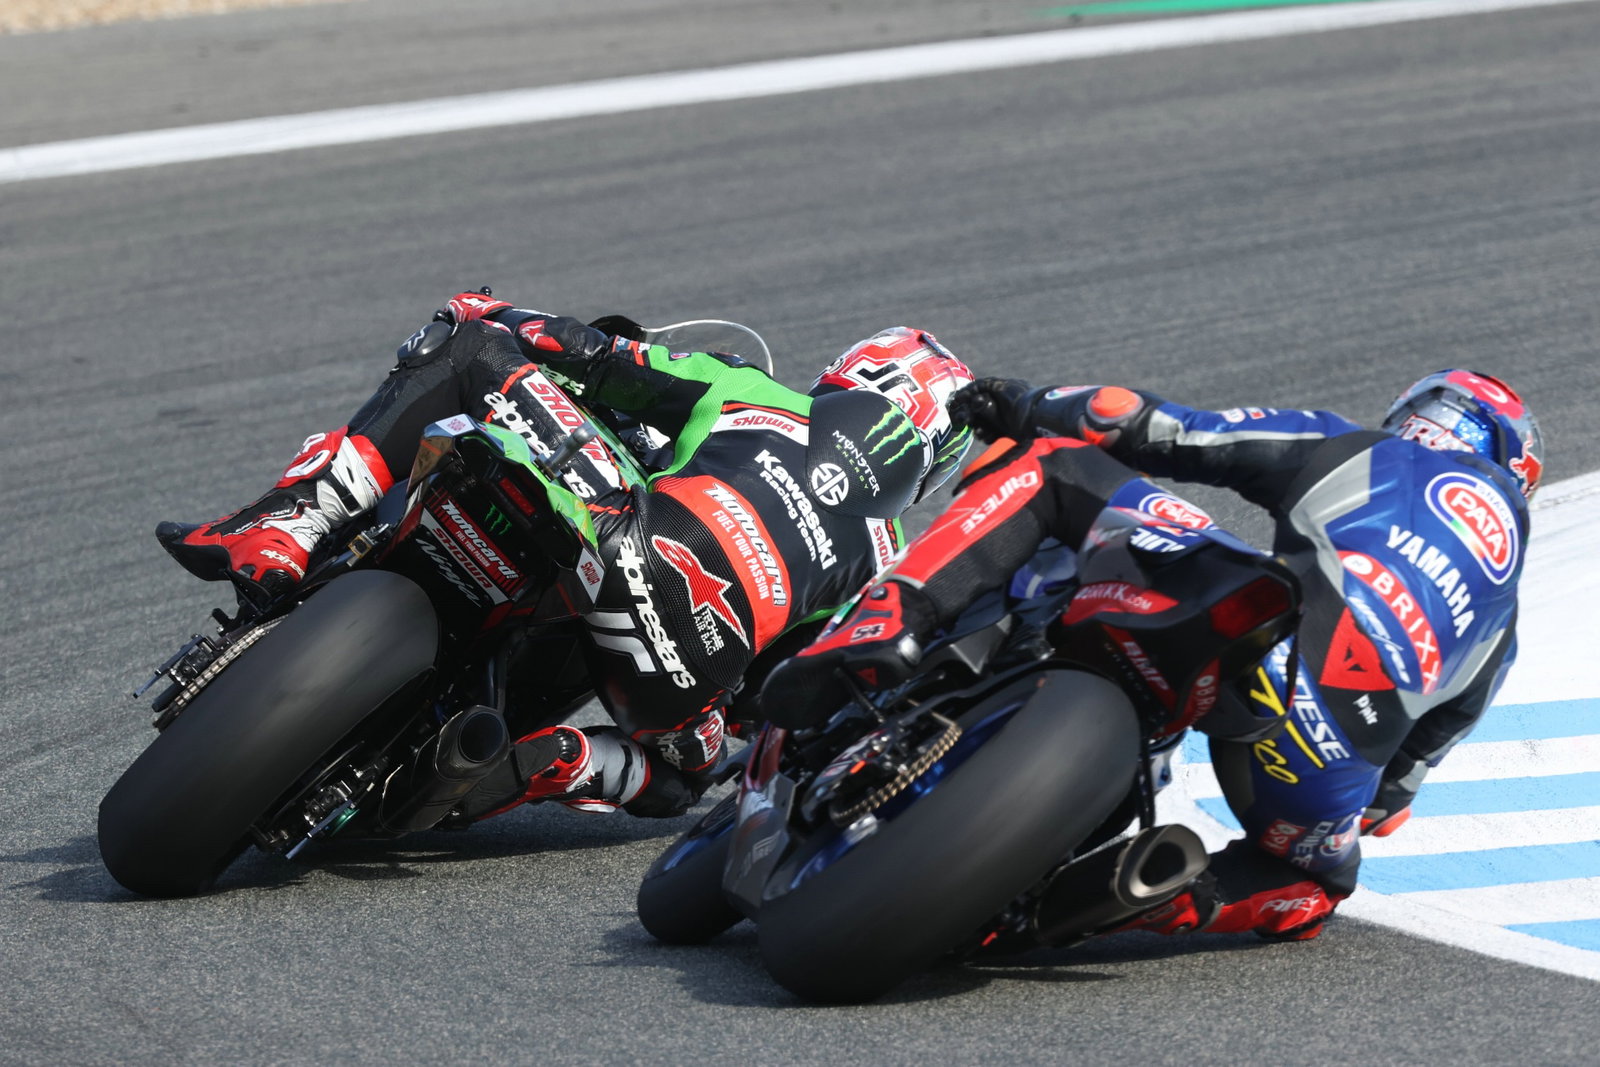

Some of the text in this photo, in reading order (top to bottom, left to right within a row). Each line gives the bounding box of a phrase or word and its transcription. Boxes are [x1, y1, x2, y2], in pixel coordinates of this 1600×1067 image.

[732, 415, 796, 433] SHOWA
[832, 430, 881, 497] MONSTER
[835, 443, 869, 489] ENERGY
[704, 483, 787, 602] Motocard
[754, 449, 838, 571] Kawasaki
[760, 470, 817, 562] Racing Team
[1450, 491, 1507, 559] PATA
[432, 527, 493, 589] SHOWA
[580, 561, 600, 586] SHOWA
[712, 509, 770, 600] FUEL YOUR PASSION
[873, 525, 892, 567] SHOW
[616, 535, 697, 689] alpinestars
[1386, 525, 1475, 639] YAMAHA
[700, 632, 717, 656] BAG
[851, 623, 885, 642] 54
[1371, 571, 1440, 685] BRIXX
